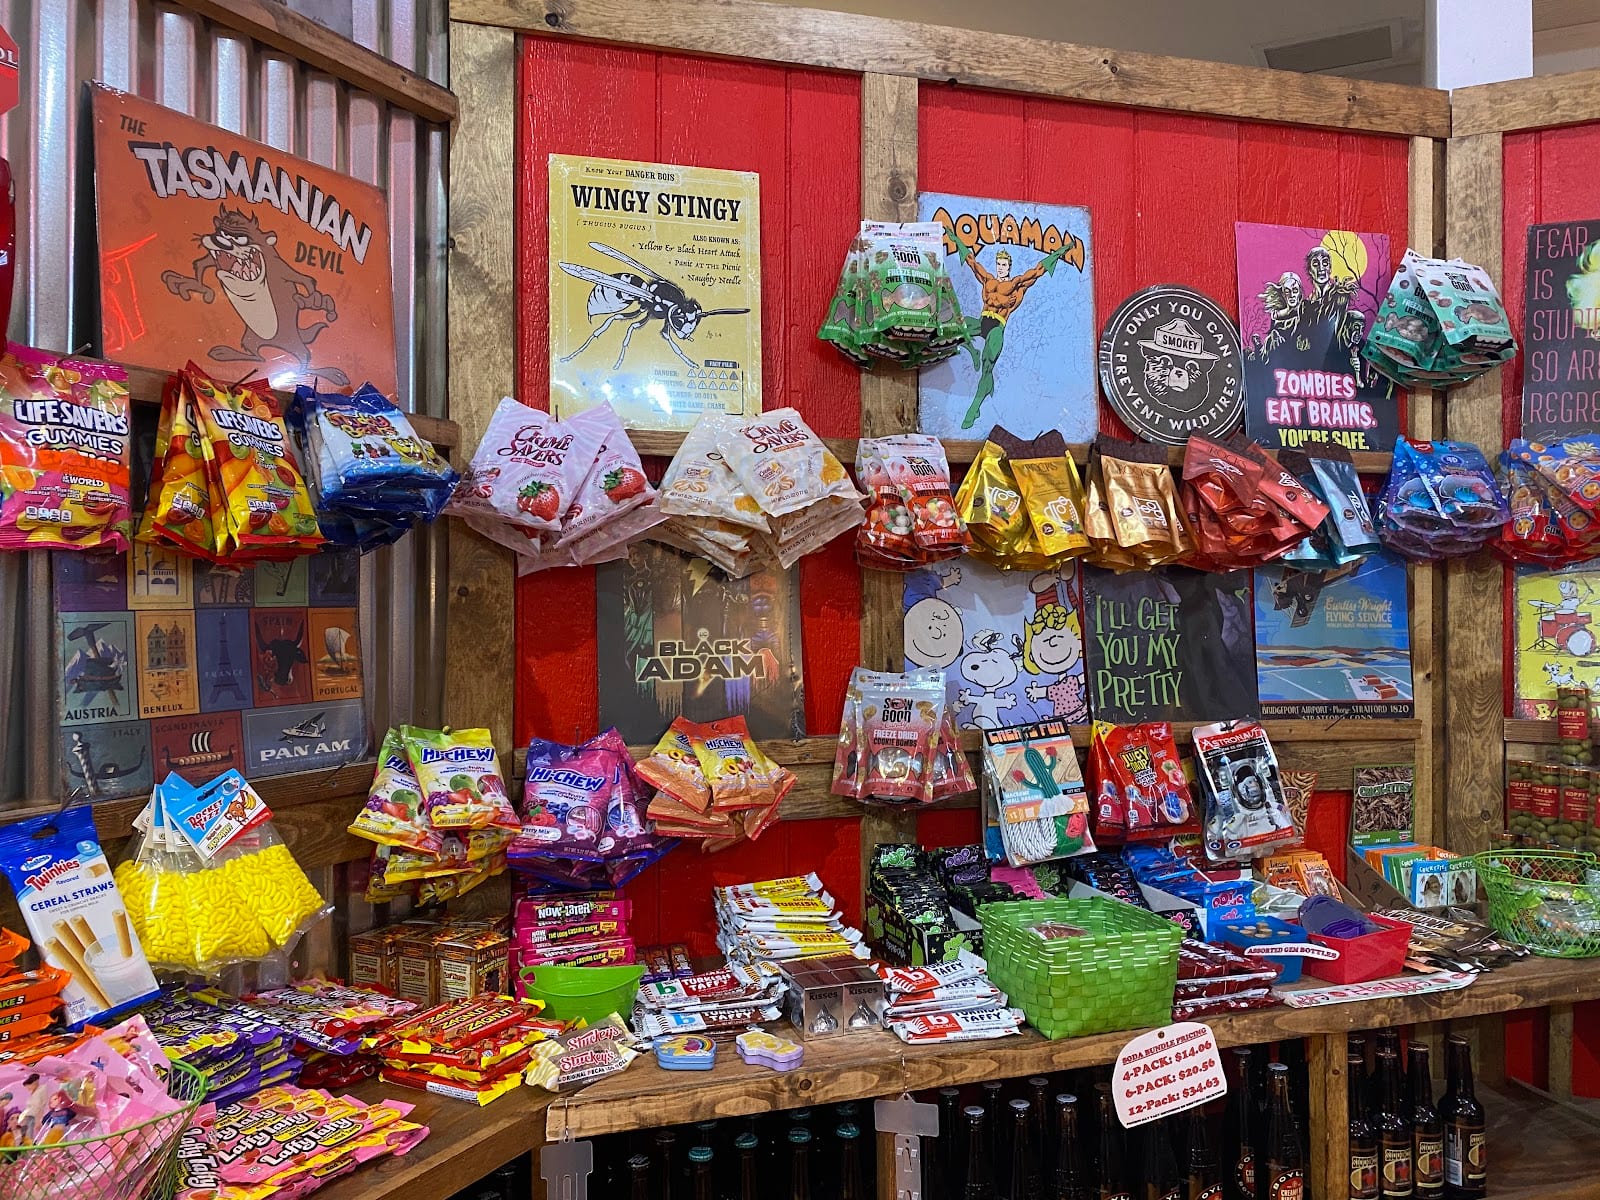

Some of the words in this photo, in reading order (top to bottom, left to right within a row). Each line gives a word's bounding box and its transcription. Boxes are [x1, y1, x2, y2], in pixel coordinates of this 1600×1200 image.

[119, 113, 146, 137] THE
[586, 166, 603, 175] Know
[625, 170, 656, 180] DANGER
[657, 172, 675, 182] BOIS
[128, 141, 372, 265] TASMANIAN
[570, 185, 650, 214] WINGY
[657, 193, 741, 222] STINGY
[638, 241, 663, 251] Yellow
[677, 244, 696, 254] Black
[698, 247, 718, 256] Heart
[720, 249, 741, 258] Attack
[693, 234, 706, 242] ALSO
[708, 236, 730, 244] KNOWN
[731, 238, 741, 246] AS:
[932, 206, 1085, 274] AQUAMAN
[1535, 226, 1588, 260] FEAR
[294, 241, 345, 276] DEVIL
[722, 263, 741, 271] Picnic
[687, 274, 717, 287] Naughty
[719, 277, 742, 285] Needle
[1533, 269, 1554, 300] IS
[1126, 303, 1161, 335] ONLY
[1168, 302, 1203, 321] YOU
[1206, 321, 1232, 358] CAN
[1162, 334, 1199, 352] SMOKEY
[1531, 350, 1558, 383] SO
[1115, 354, 1164, 425] PREVENT
[1169, 376, 1236, 431] WILDFIRES
[1275, 369, 1357, 400] ZOMBIES
[14, 399, 61, 425] LIFE
[60, 401, 129, 436] SAVERS
[1265, 398, 1306, 427] EAT
[1307, 401, 1377, 429] BRAINS.
[26, 428, 124, 455] GUMMIES
[228, 432, 285, 458] GUMMIES
[514, 425, 575, 451] CREME
[752, 430, 809, 454] SAVERS
[1278, 428, 1329, 448] YOU'RE
[1332, 431, 1370, 450] SAFE.
[497, 438, 567, 466] SAVERS
[70, 476, 104, 487] WORLD
[911, 465, 937, 476] GOOD
[261, 614, 292, 628] SPAIN
[1096, 594, 1131, 633] I'LL
[1137, 598, 1180, 632] GET
[1326, 611, 1354, 623] FLYING
[1358, 612, 1393, 623] SERVICE
[658, 639, 753, 657] BLACK
[1096, 634, 1138, 669] YOU
[1147, 634, 1181, 669] MY
[203, 668, 246, 679] FRANCE
[636, 655, 767, 683] ADAM
[318, 685, 360, 697] PORTUGAL
[1096, 670, 1183, 717] PRETTY
[64, 707, 120, 722] AUSTRIA
[143, 703, 184, 715] BENELUX
[882, 710, 912, 723] GOOD
[1262, 705, 1301, 715] BRIDGEPORT
[1301, 705, 1329, 715] AIRPORT
[1352, 705, 1388, 713] STRATFORD
[1390, 705, 1410, 713] 1820
[111, 726, 142, 738] ITALY
[154, 718, 225, 735] SCANDINAVIA
[874, 730, 897, 739] FREEZE
[898, 731, 919, 740] DRIED
[874, 738, 895, 746] COOKIE
[1202, 727, 1263, 750] ASTRONAUT
[259, 743, 310, 762] PAN
[313, 739, 351, 753] AM
[421, 747, 495, 765] HI-CHEW
[1121, 746, 1150, 769] JUICY
[1130, 759, 1148, 773] DROP
[529, 767, 605, 792] HI-CHEW
[188, 799, 224, 830] ROCKET
[197, 809, 221, 831] FIZZ
[81, 842, 91, 850] 5
[24, 859, 81, 892] Twinkies
[56, 875, 80, 886] flavored
[30, 895, 71, 912] CEREAL
[72, 881, 115, 900] STRAWS
[538, 907, 561, 919] NOW
[565, 902, 591, 917] LATER
[1248, 947, 1283, 955] ASSORTED
[1300, 948, 1337, 959] BOTTLES
[682, 974, 732, 986] TURKISH
[933, 962, 965, 976] TAFFY
[689, 980, 729, 991] TAFFY
[17, 996, 25, 1004] 5
[12, 1014, 20, 1022] 5
[427, 1001, 474, 1024] ZAGNUT
[442, 1006, 490, 1030] ZAGNUT
[468, 1007, 513, 1032] ZAGNUT
[709, 1012, 753, 1021] TAFFY
[961, 1013, 1001, 1022] TAFFY
[2, 1032, 10, 1041] 5
[567, 1025, 622, 1051] Stuckey's
[1122, 1053, 1143, 1064] SODA
[1145, 1040, 1176, 1057] BUNDLE
[1176, 1028, 1207, 1044] PRICING
[559, 1050, 616, 1072] Stuckey's
[1122, 1056, 1173, 1082] 4-PACK:
[1174, 1040, 1212, 1063] $14.06
[562, 1071, 587, 1082] ORIGINAL
[1125, 1074, 1176, 1099] 6-PACK:
[1178, 1058, 1216, 1081] $20.56
[1128, 1092, 1181, 1117] 12-Pack:
[1182, 1077, 1220, 1099] $34.63
[218, 1128, 273, 1164] Laffy
[264, 1111, 312, 1136] Taffy
[259, 1132, 321, 1167] Laffy
[308, 1116, 353, 1144] Taffy
